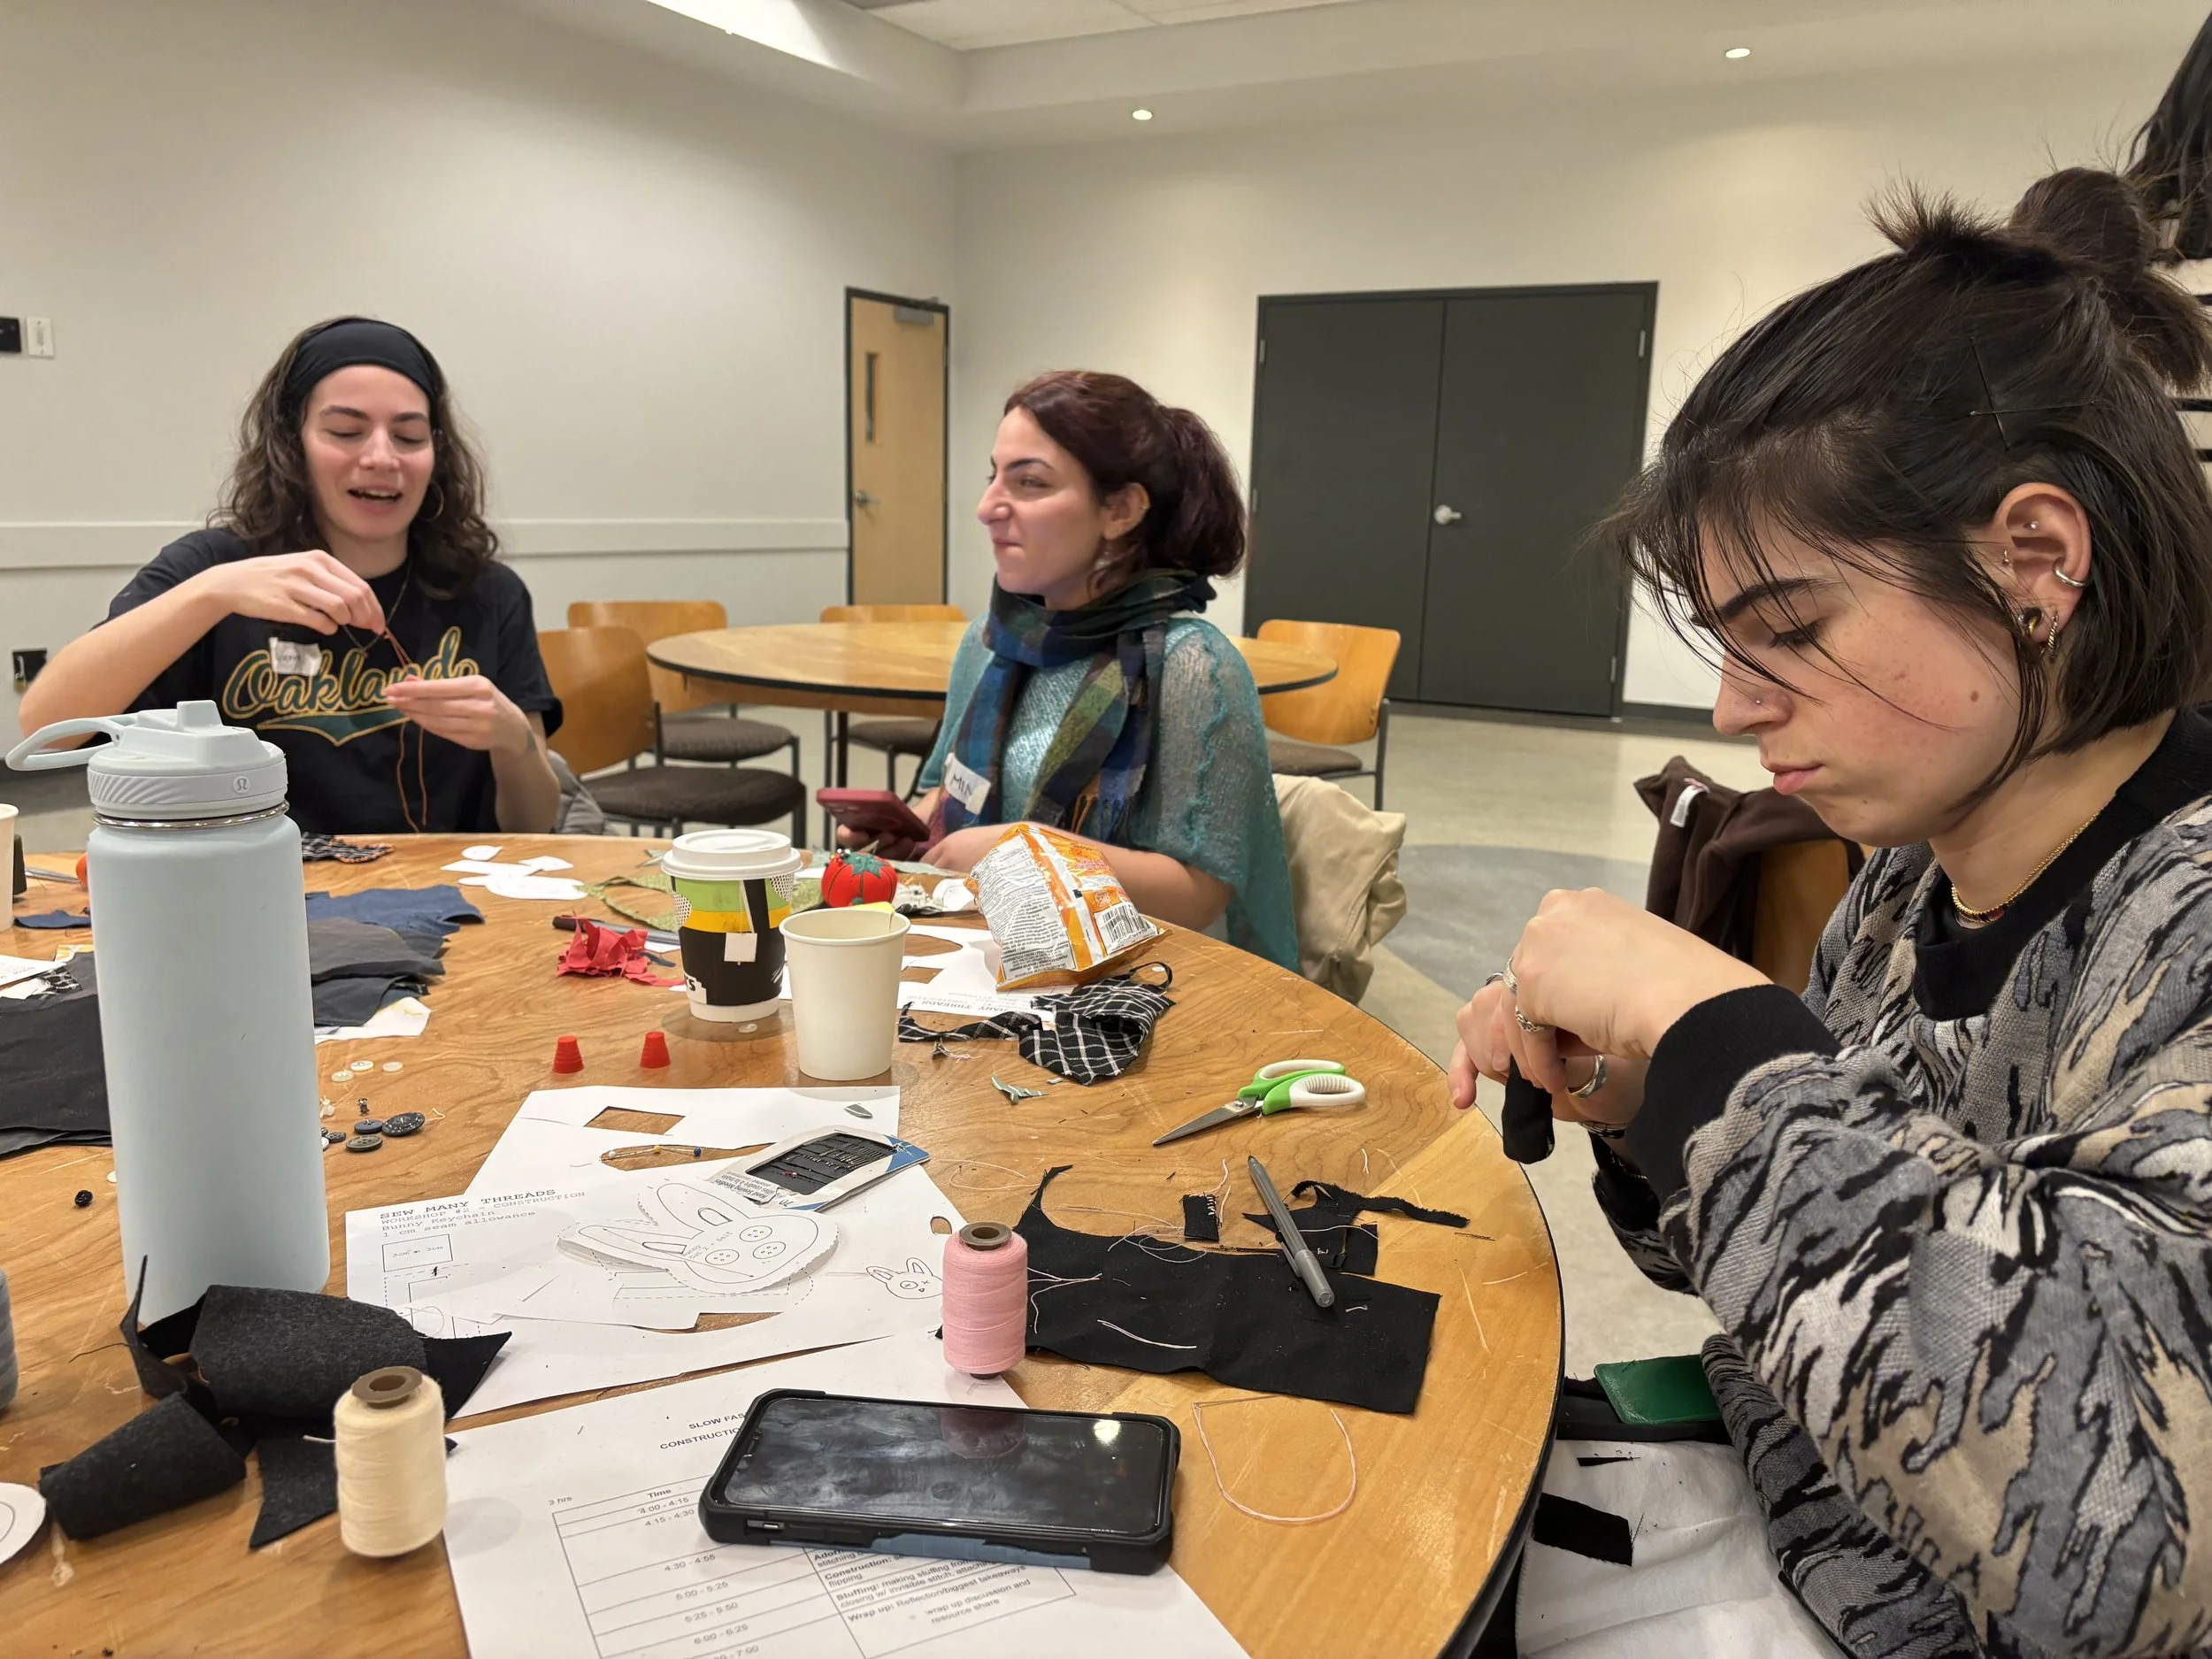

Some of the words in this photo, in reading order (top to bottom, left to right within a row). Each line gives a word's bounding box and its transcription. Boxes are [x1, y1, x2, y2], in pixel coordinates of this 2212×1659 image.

[714, 1178, 735, 1191] Needles
[735, 1186, 754, 1196] Sewing
[380, 1209, 414, 1219] SEW
[426, 1201, 469, 1213] MANY
[480, 1189, 556, 1204] THREADS
[751, 1190, 768, 1200] Hand
[381, 1211, 446, 1225] WORKSHOP
[493, 1191, 586, 1209] CONSTRUCTION
[382, 1220, 423, 1232] Bunny
[432, 1210, 495, 1224] Keychain
[424, 1221, 457, 1232] seam
[465, 1211, 536, 1225] allowance
[688, 1417, 721, 1430] SLOW
[724, 1412, 745, 1422] FAS
[659, 1427, 741, 1449] CONSTRUCTIO
[557, 1495, 572, 1504] hrs
[647, 1488, 672, 1499] Time
[639, 1503, 661, 1515] 4:00
[668, 1496, 689, 1508] 4:15
[645, 1516, 665, 1526] 4:15
[673, 1509, 695, 1520] 4:30
[664, 1562, 687, 1571] 4:30
[695, 1554, 716, 1563] 4:55
[817, 1553, 856, 1568] stitching
[824, 1556, 892, 1580] Construction:
[828, 1573, 863, 1587] flipping
[836, 1583, 880, 1601] Stuffing:
[881, 1574, 916, 1587] making
[917, 1564, 949, 1579] stuffing
[676, 1590, 698, 1601] 5:00
[706, 1581, 728, 1593] 5:25
[840, 1594, 874, 1609] closing
[888, 1579, 926, 1594] invisible
[848, 1609, 876, 1622] Wrap
[878, 1603, 895, 1614] up:
[979, 1565, 1026, 1583] takeaways
[925, 1603, 949, 1615] wrap
[951, 1599, 964, 1609] up
[964, 1585, 1012, 1603] discussion
[1013, 1578, 1031, 1590] and
[931, 1606, 972, 1624] resource
[973, 1598, 1000, 1611] share
